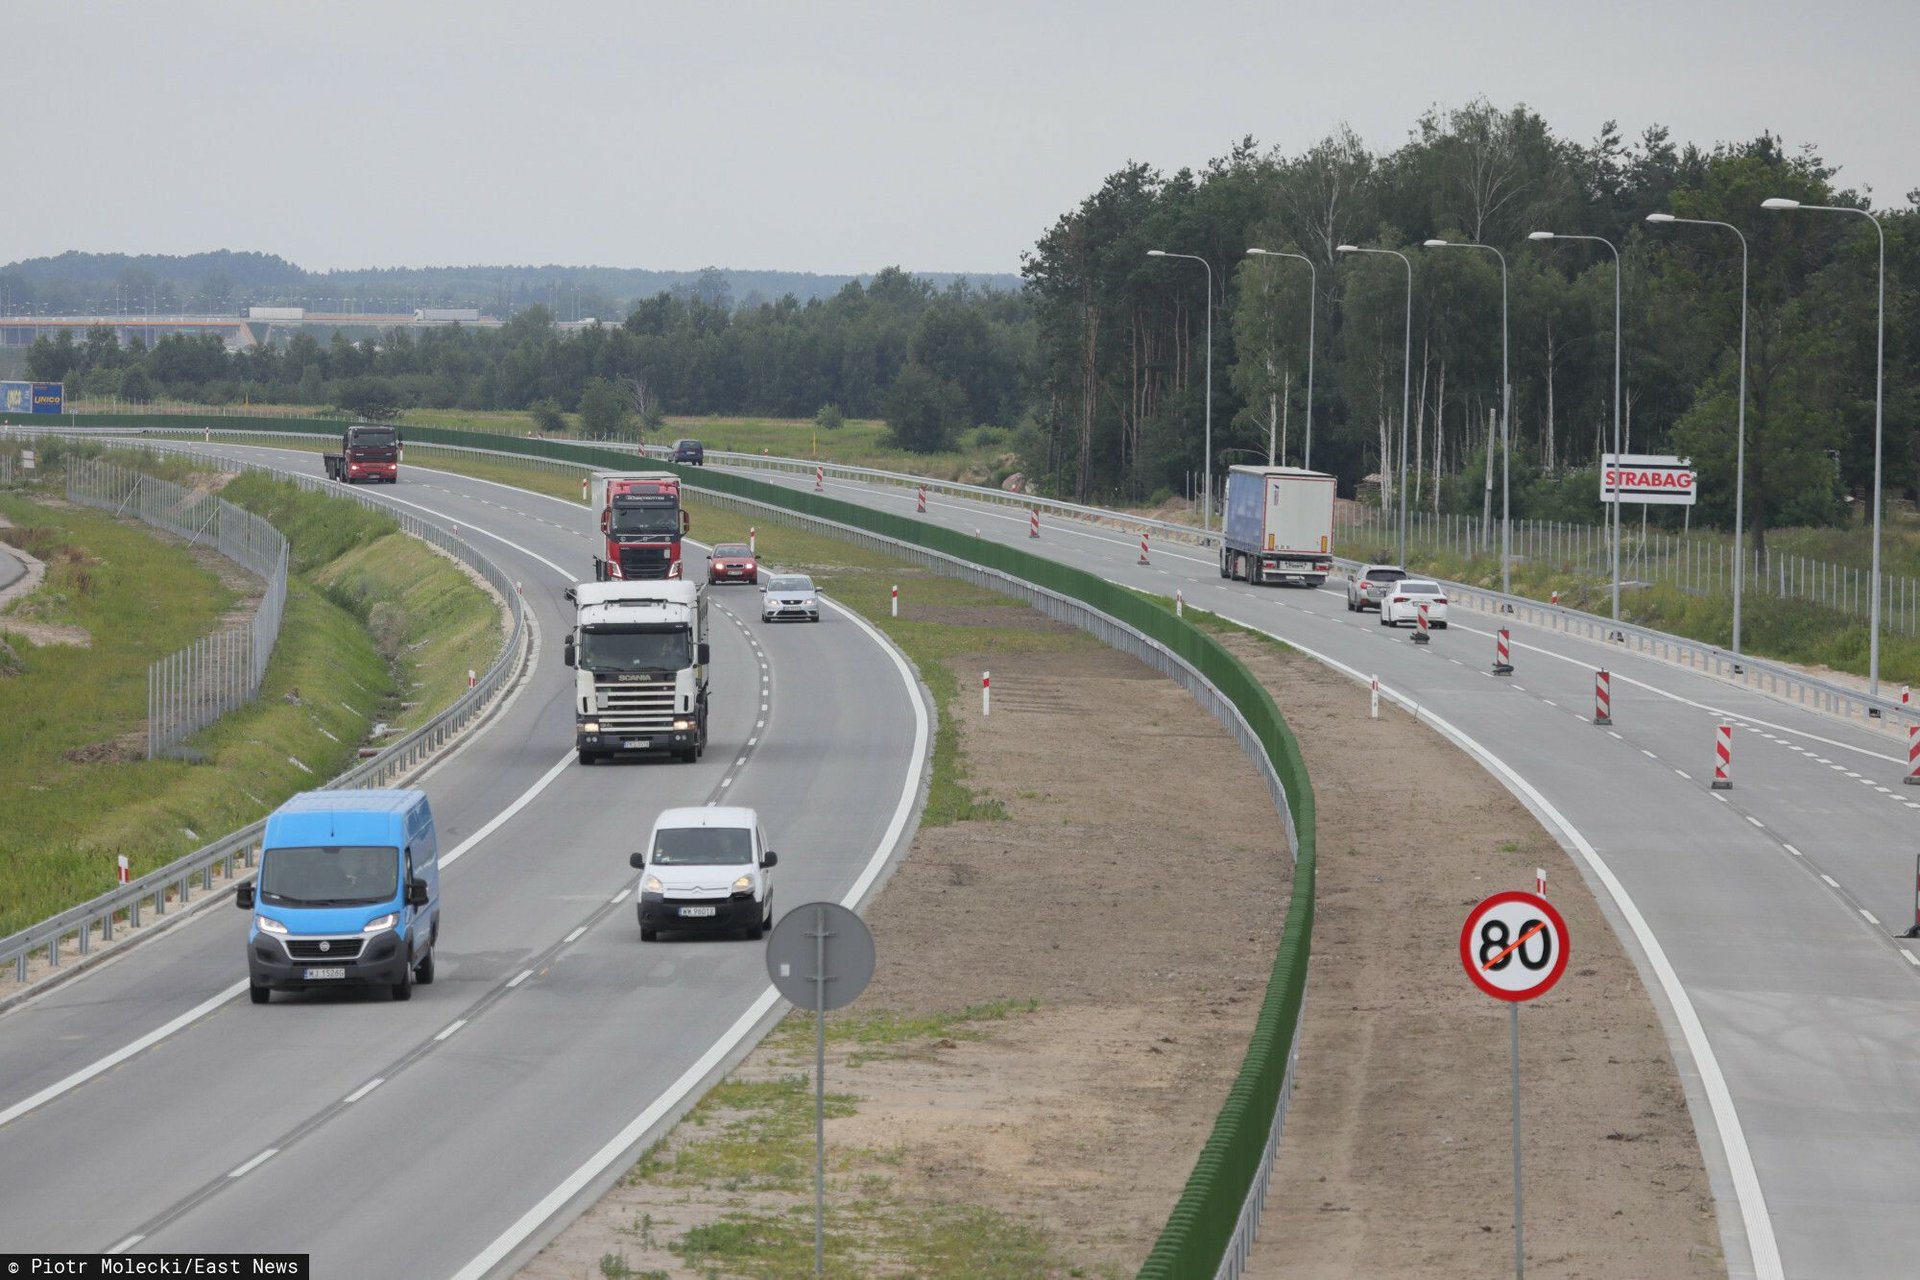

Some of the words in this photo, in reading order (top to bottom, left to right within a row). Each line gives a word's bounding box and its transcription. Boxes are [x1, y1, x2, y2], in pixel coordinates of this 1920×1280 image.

[34, 396, 61, 404] UNICO
[1605, 471, 1692, 489] STRABAG
[618, 674, 651, 682] SCANIA
[1479, 919, 1552, 971] 80
